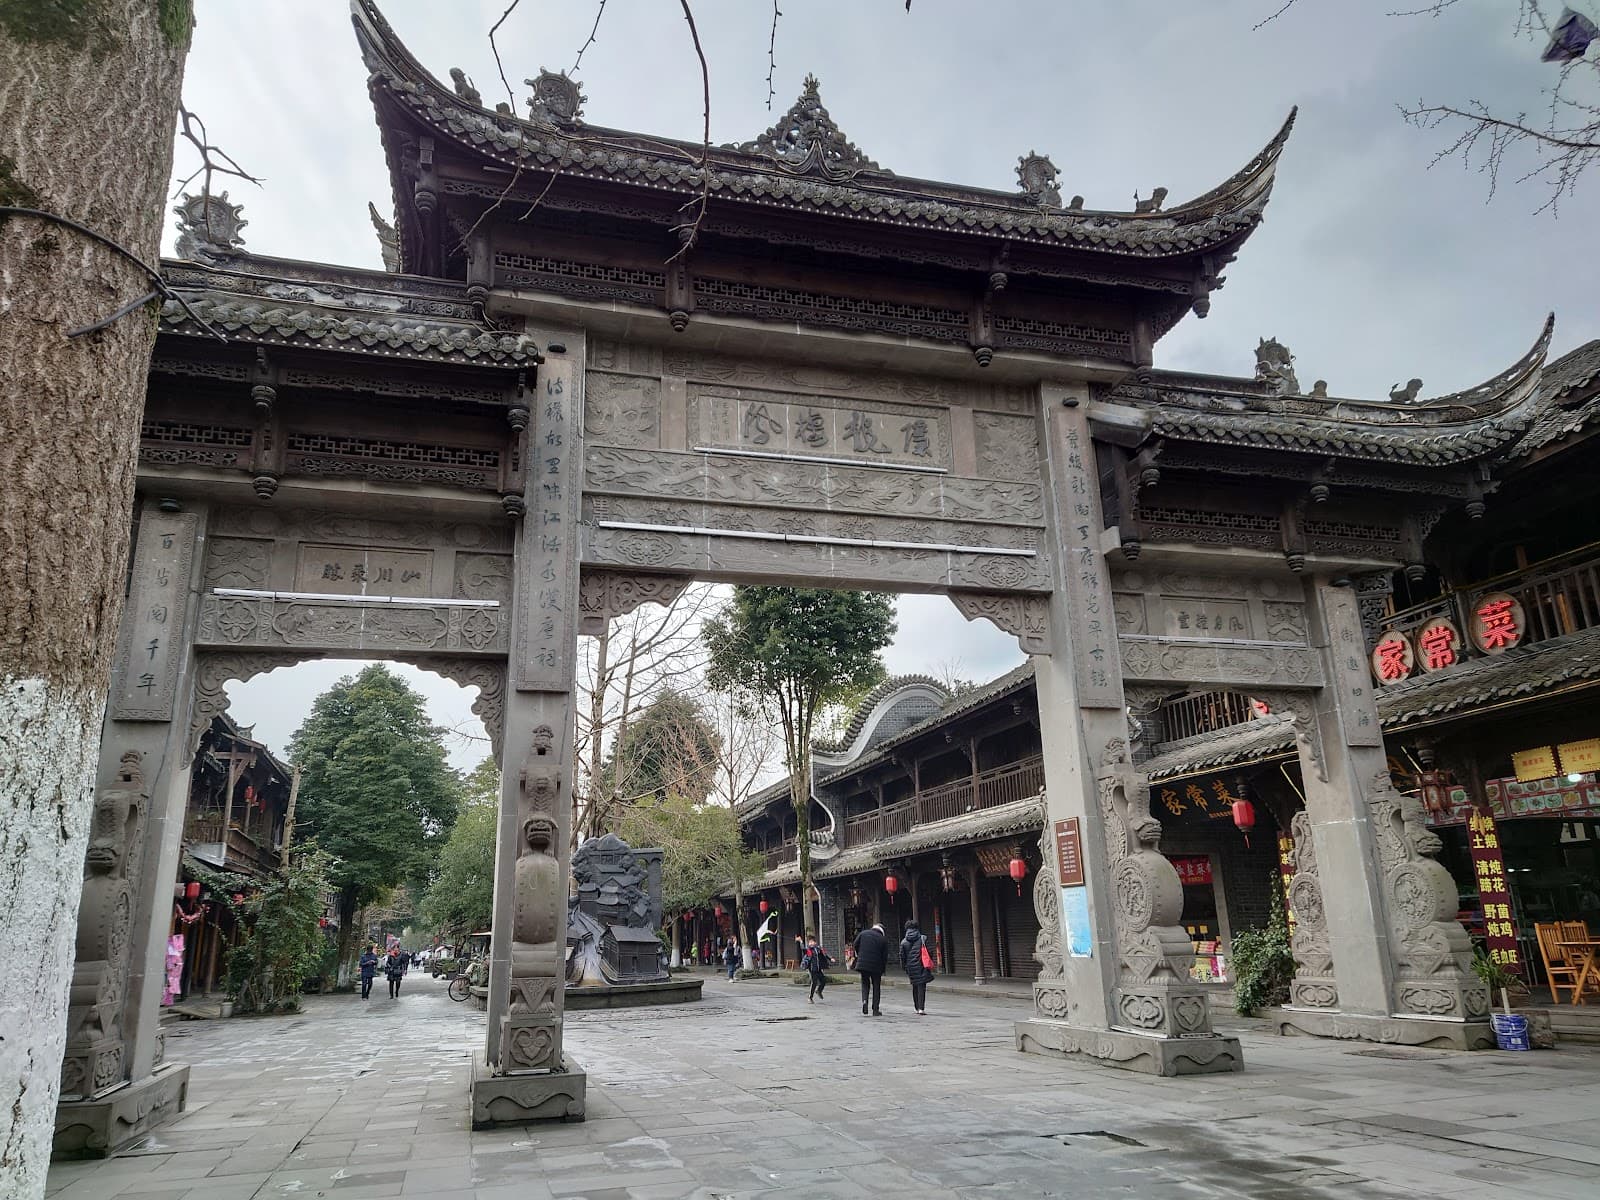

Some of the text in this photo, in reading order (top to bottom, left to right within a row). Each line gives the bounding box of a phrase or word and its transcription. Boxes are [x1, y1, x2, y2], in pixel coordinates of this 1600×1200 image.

[1376, 600, 1519, 680] 家常菜
[1160, 780, 1241, 816] 家常菜
[1472, 834, 1498, 849] 土鹅
[1476, 859, 1503, 875] 清炖
[1479, 877, 1505, 893] 蹄花
[1486, 921, 1513, 938] 炖鸡
[1491, 948, 1519, 965] 毛血旺
